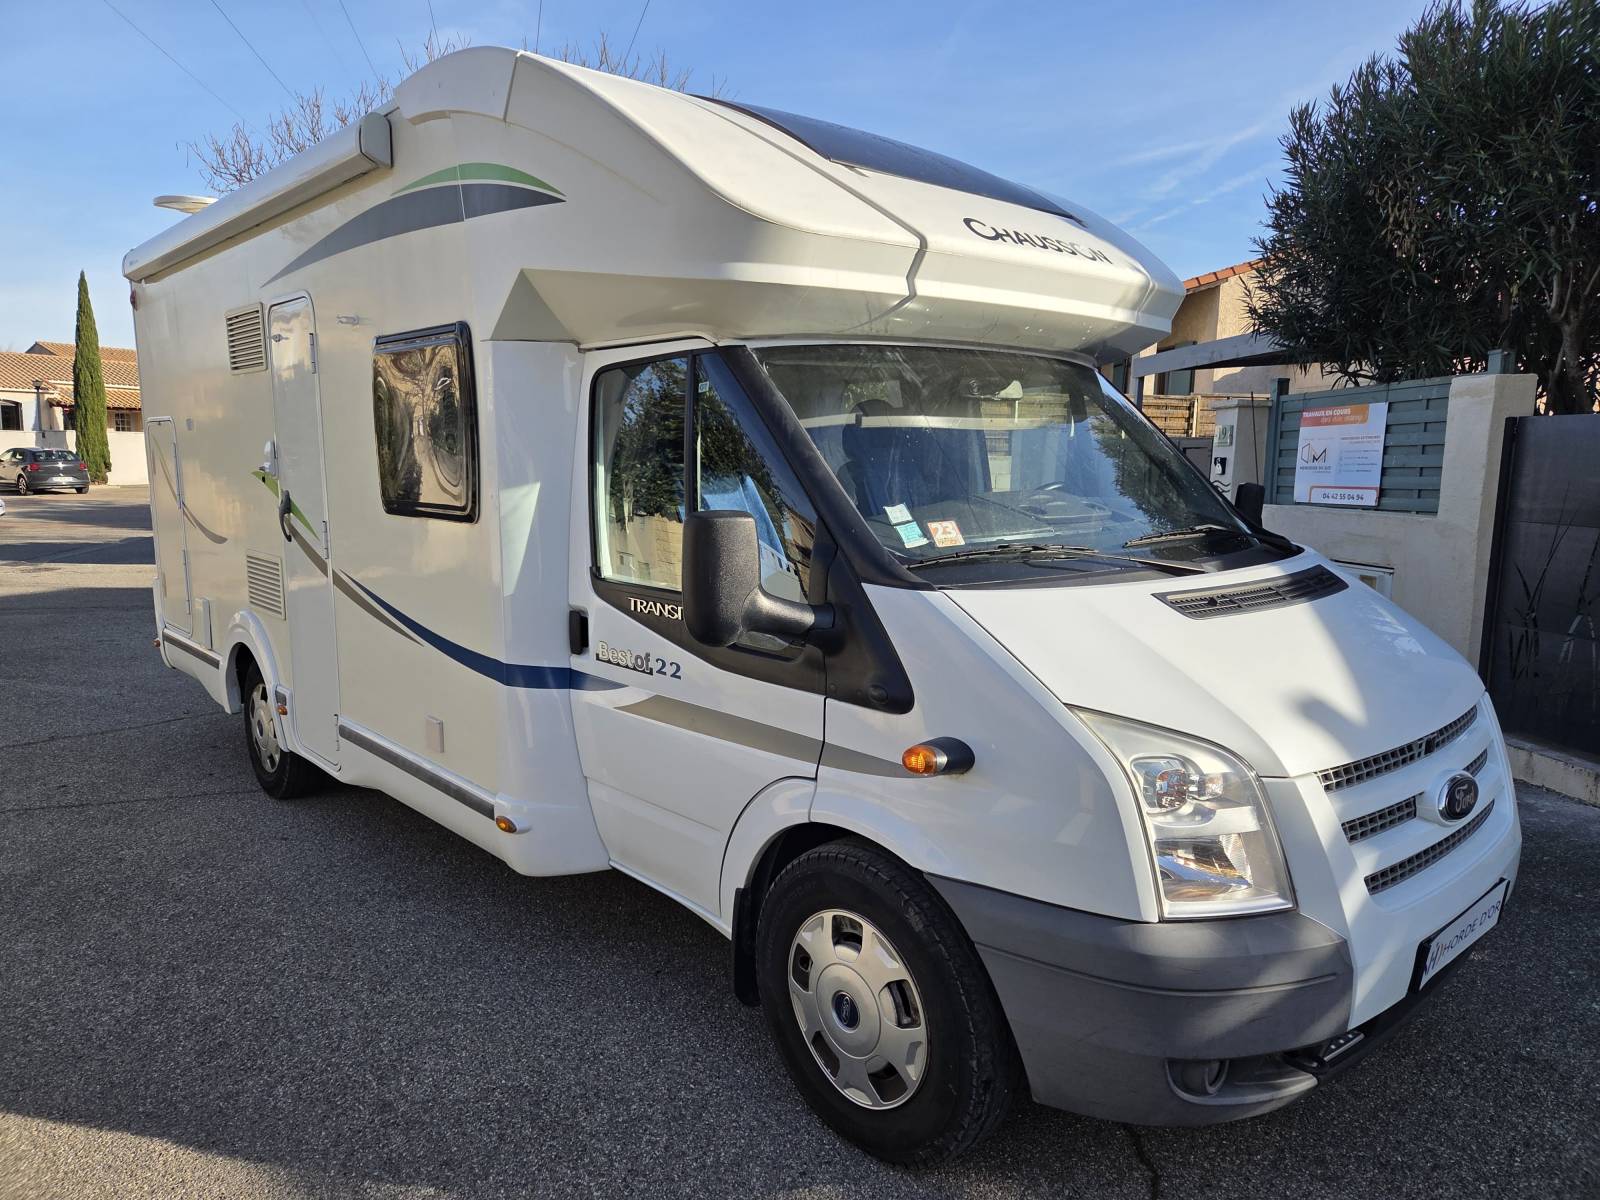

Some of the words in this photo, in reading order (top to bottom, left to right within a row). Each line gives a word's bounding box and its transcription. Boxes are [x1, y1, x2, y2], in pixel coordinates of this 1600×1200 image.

[963, 217, 1113, 264] CHAUSSON
[628, 597, 684, 621] TRANSI
[655, 657, 682, 680] 22
[1454, 783, 1476, 813] Ford
[1441, 918, 1479, 957] HORDE
